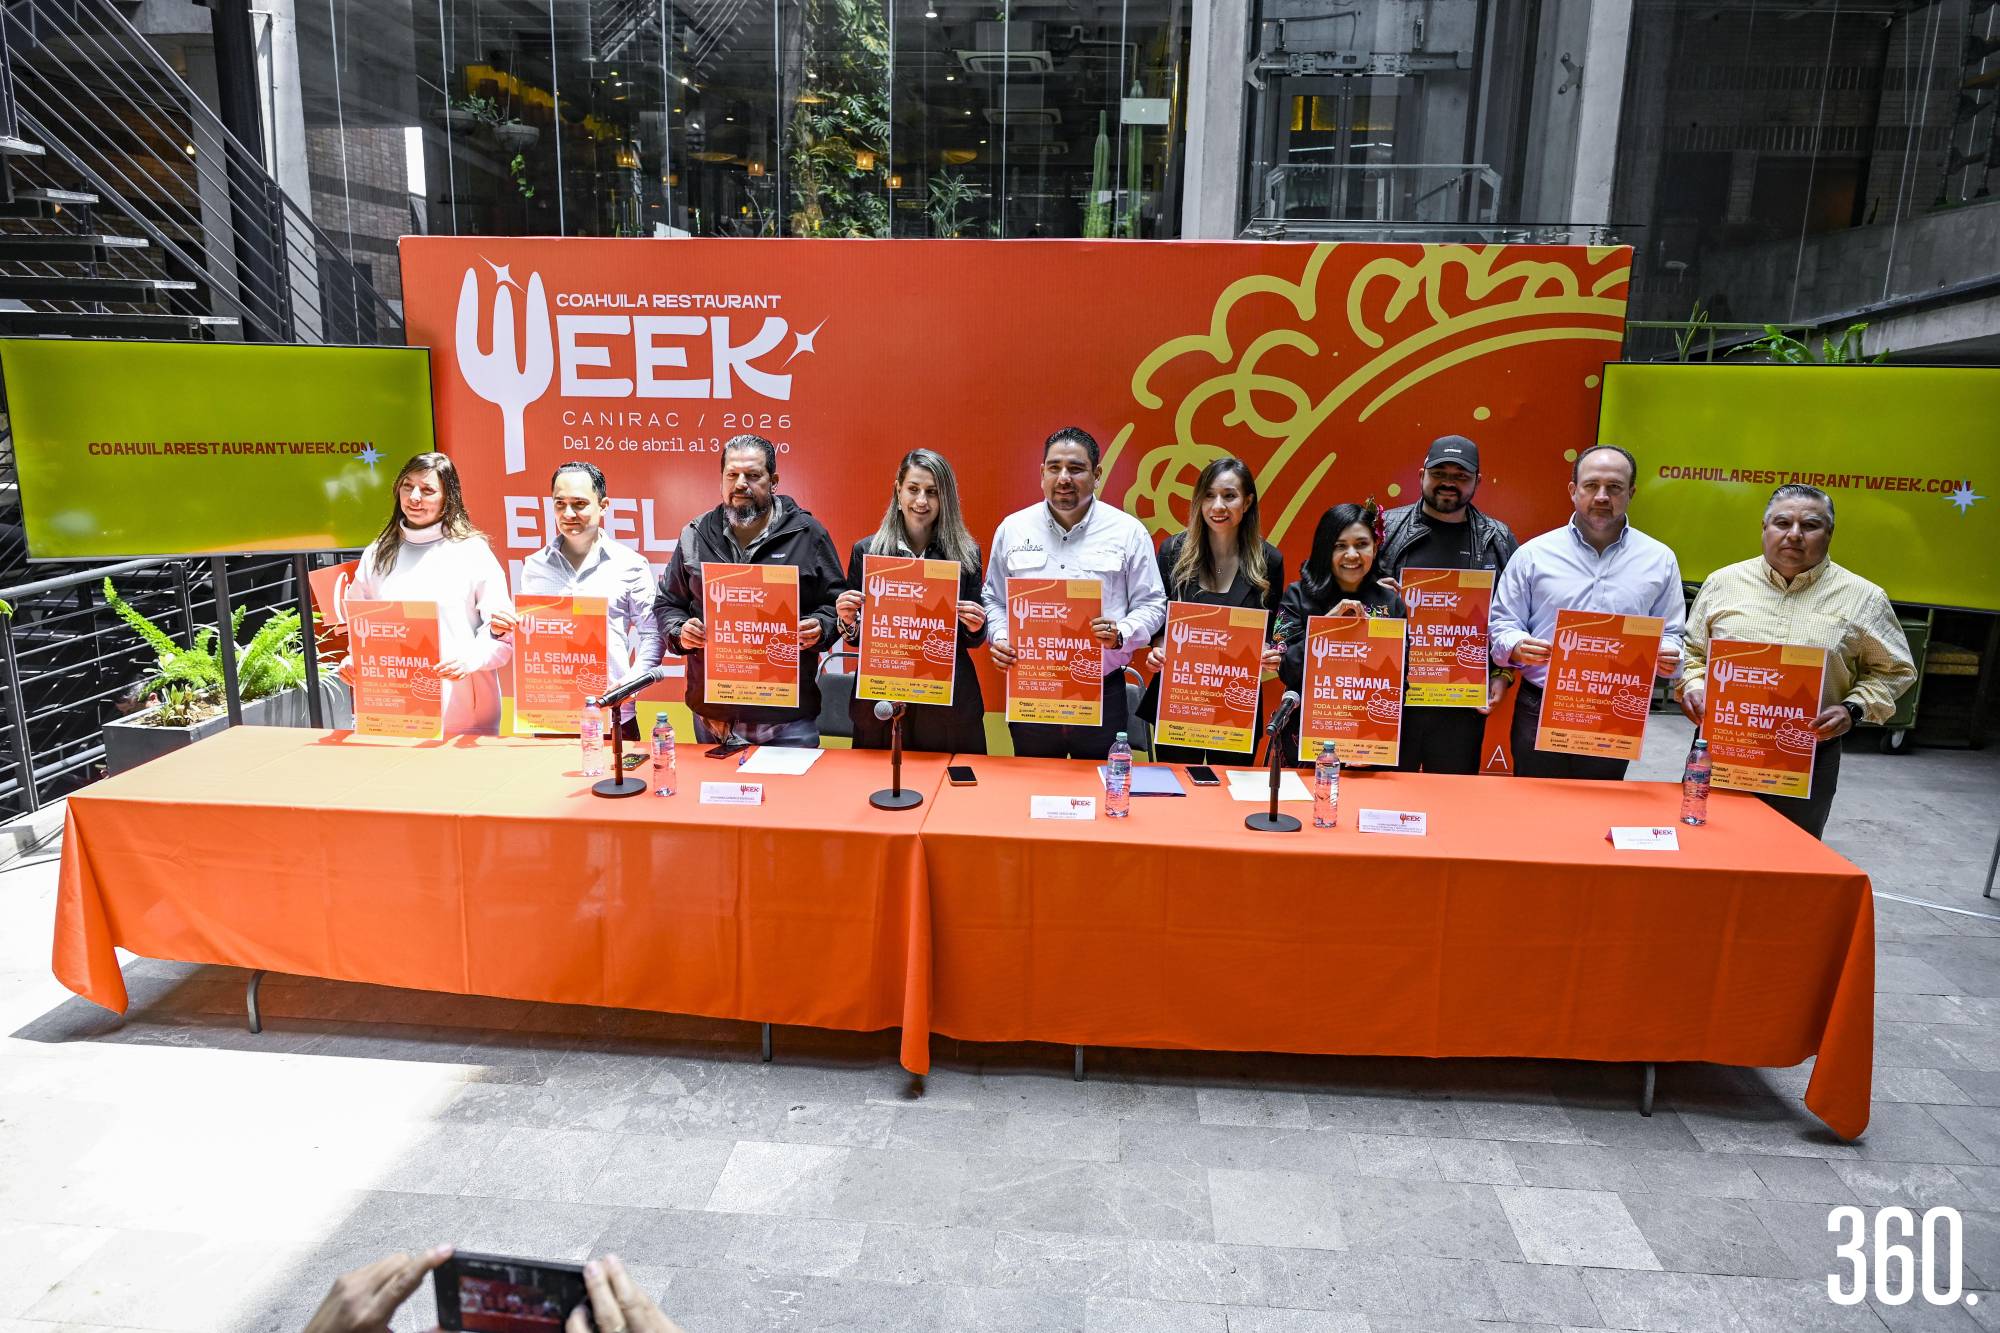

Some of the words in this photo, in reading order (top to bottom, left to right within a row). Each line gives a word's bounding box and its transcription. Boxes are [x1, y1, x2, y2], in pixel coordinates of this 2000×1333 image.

[556, 293, 649, 308] COAHUILA
[652, 294, 782, 309] RESTAURANT
[562, 411, 680, 428] CANIRAC
[723, 414, 792, 429] 2026
[563, 435, 591, 450] Del
[595, 436, 615, 451] 26
[618, 437, 638, 452] de
[642, 437, 685, 453] abril
[688, 438, 705, 453] al
[710, 438, 720, 452] 3
[714, 619, 730, 631] LA
[734, 620, 787, 633] SEMANA
[871, 613, 888, 626] LA
[891, 615, 945, 630] SEMANA
[870, 626, 896, 638] DEL
[899, 628, 921, 640] RW
[1408, 623, 1423, 635] LA
[1426, 624, 1477, 635] SEMANA
[714, 632, 739, 643] DEL
[742, 633, 764, 645] RW
[1017, 635, 1033, 647] LA
[1037, 636, 1090, 649] SEMANA
[1433, 636, 1455, 647] RW
[360, 654, 375, 666] LA
[379, 655, 429, 668] SEMANA
[524, 651, 540, 662] LA
[544, 651, 596, 664] SEMANA
[1017, 648, 1042, 660] DEL
[1045, 649, 1067, 661] RW
[360, 666, 384, 677] DEL
[387, 667, 408, 679] RW
[524, 663, 549, 674] DEL
[552, 664, 574, 675] RW
[1172, 660, 1190, 672] LA
[1193, 662, 1248, 678] SEMANA
[1171, 672, 1197, 685] DEL
[1200, 675, 1223, 688] RW
[1313, 674, 1331, 687] LA
[1334, 675, 1390, 689] SEMANA
[1557, 667, 1577, 680] LA
[1580, 669, 1641, 686] SEMANA
[1313, 687, 1339, 699] DEL
[1342, 688, 1365, 701] RW
[1555, 679, 1584, 692] DEL
[1586, 682, 1613, 695] RW
[1714, 699, 1734, 712] LA
[1738, 702, 1804, 719] SEMANA
[1713, 712, 1743, 726] DEL
[1747, 715, 1774, 729] RW
[1486, 744, 1508, 770] A
